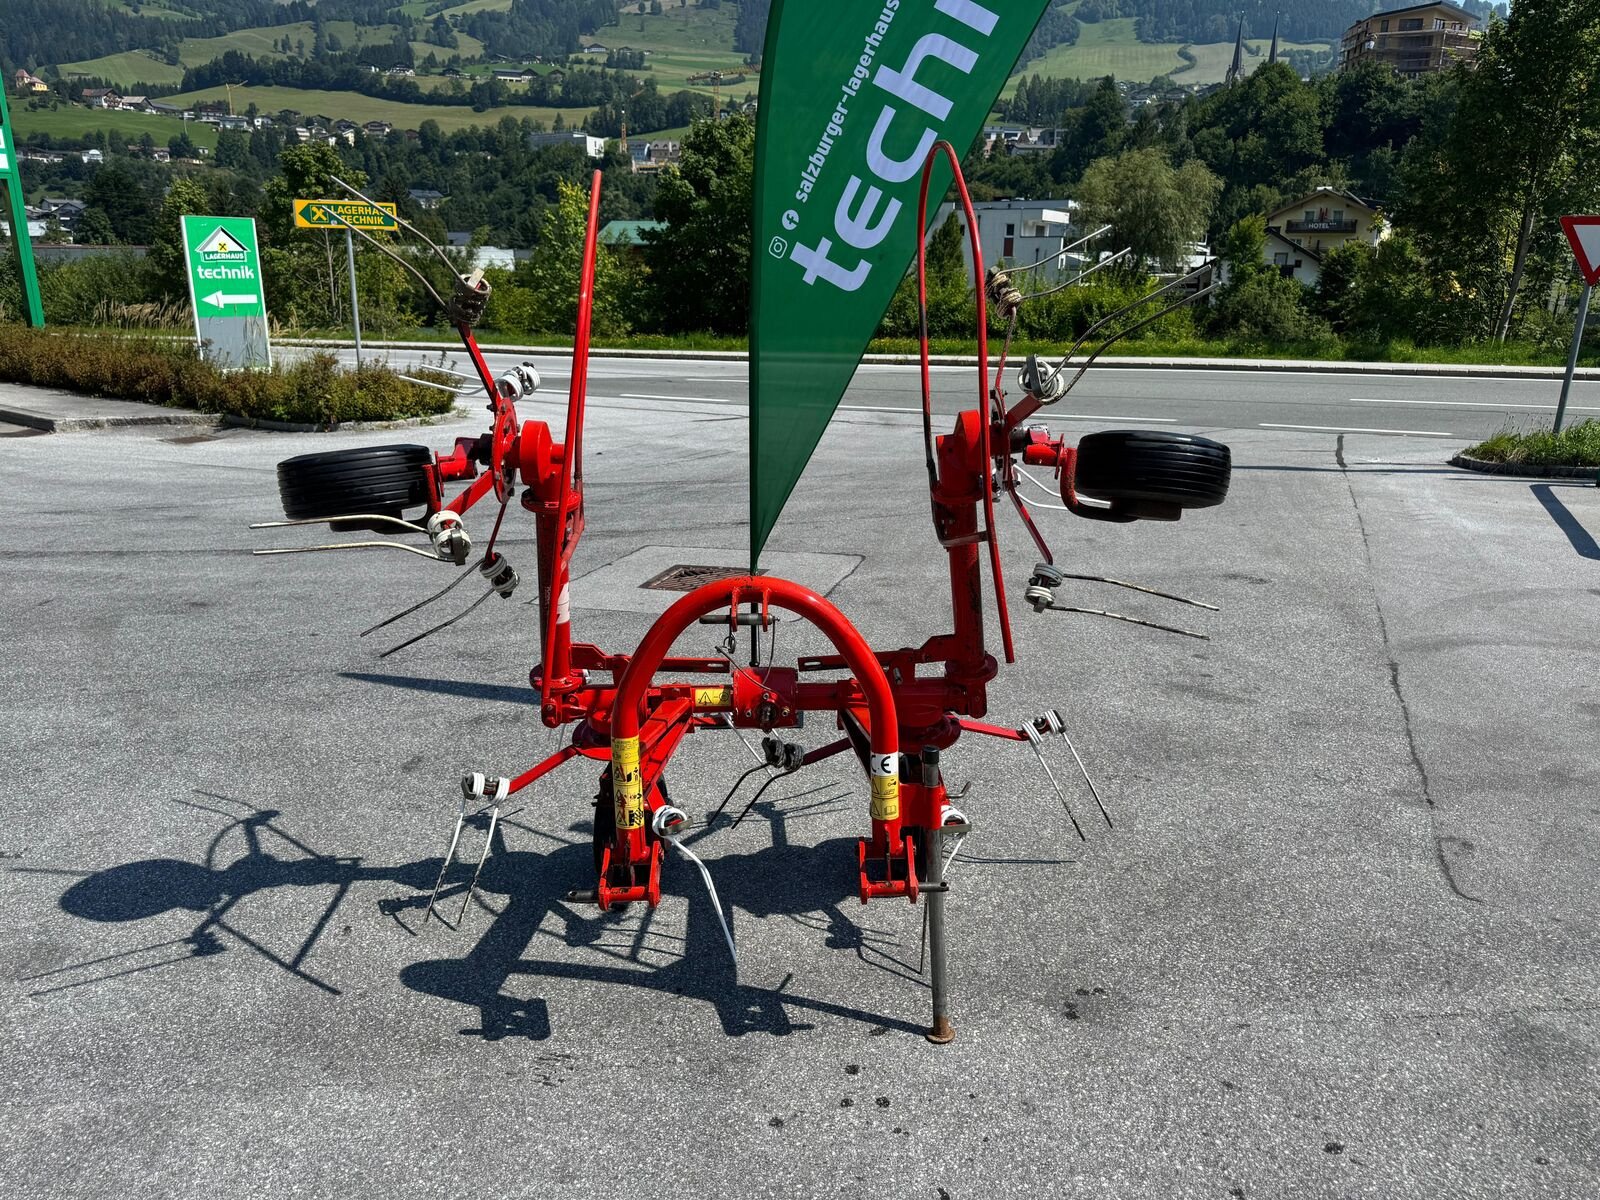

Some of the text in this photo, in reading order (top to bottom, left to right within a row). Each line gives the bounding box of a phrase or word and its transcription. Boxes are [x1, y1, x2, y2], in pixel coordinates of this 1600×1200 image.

[795, 0, 900, 202] salzburger-lagerhaus
[204, 252, 244, 260] LAGERHAUS
[197, 265, 254, 279] technik
[871, 754, 891, 773] CE
